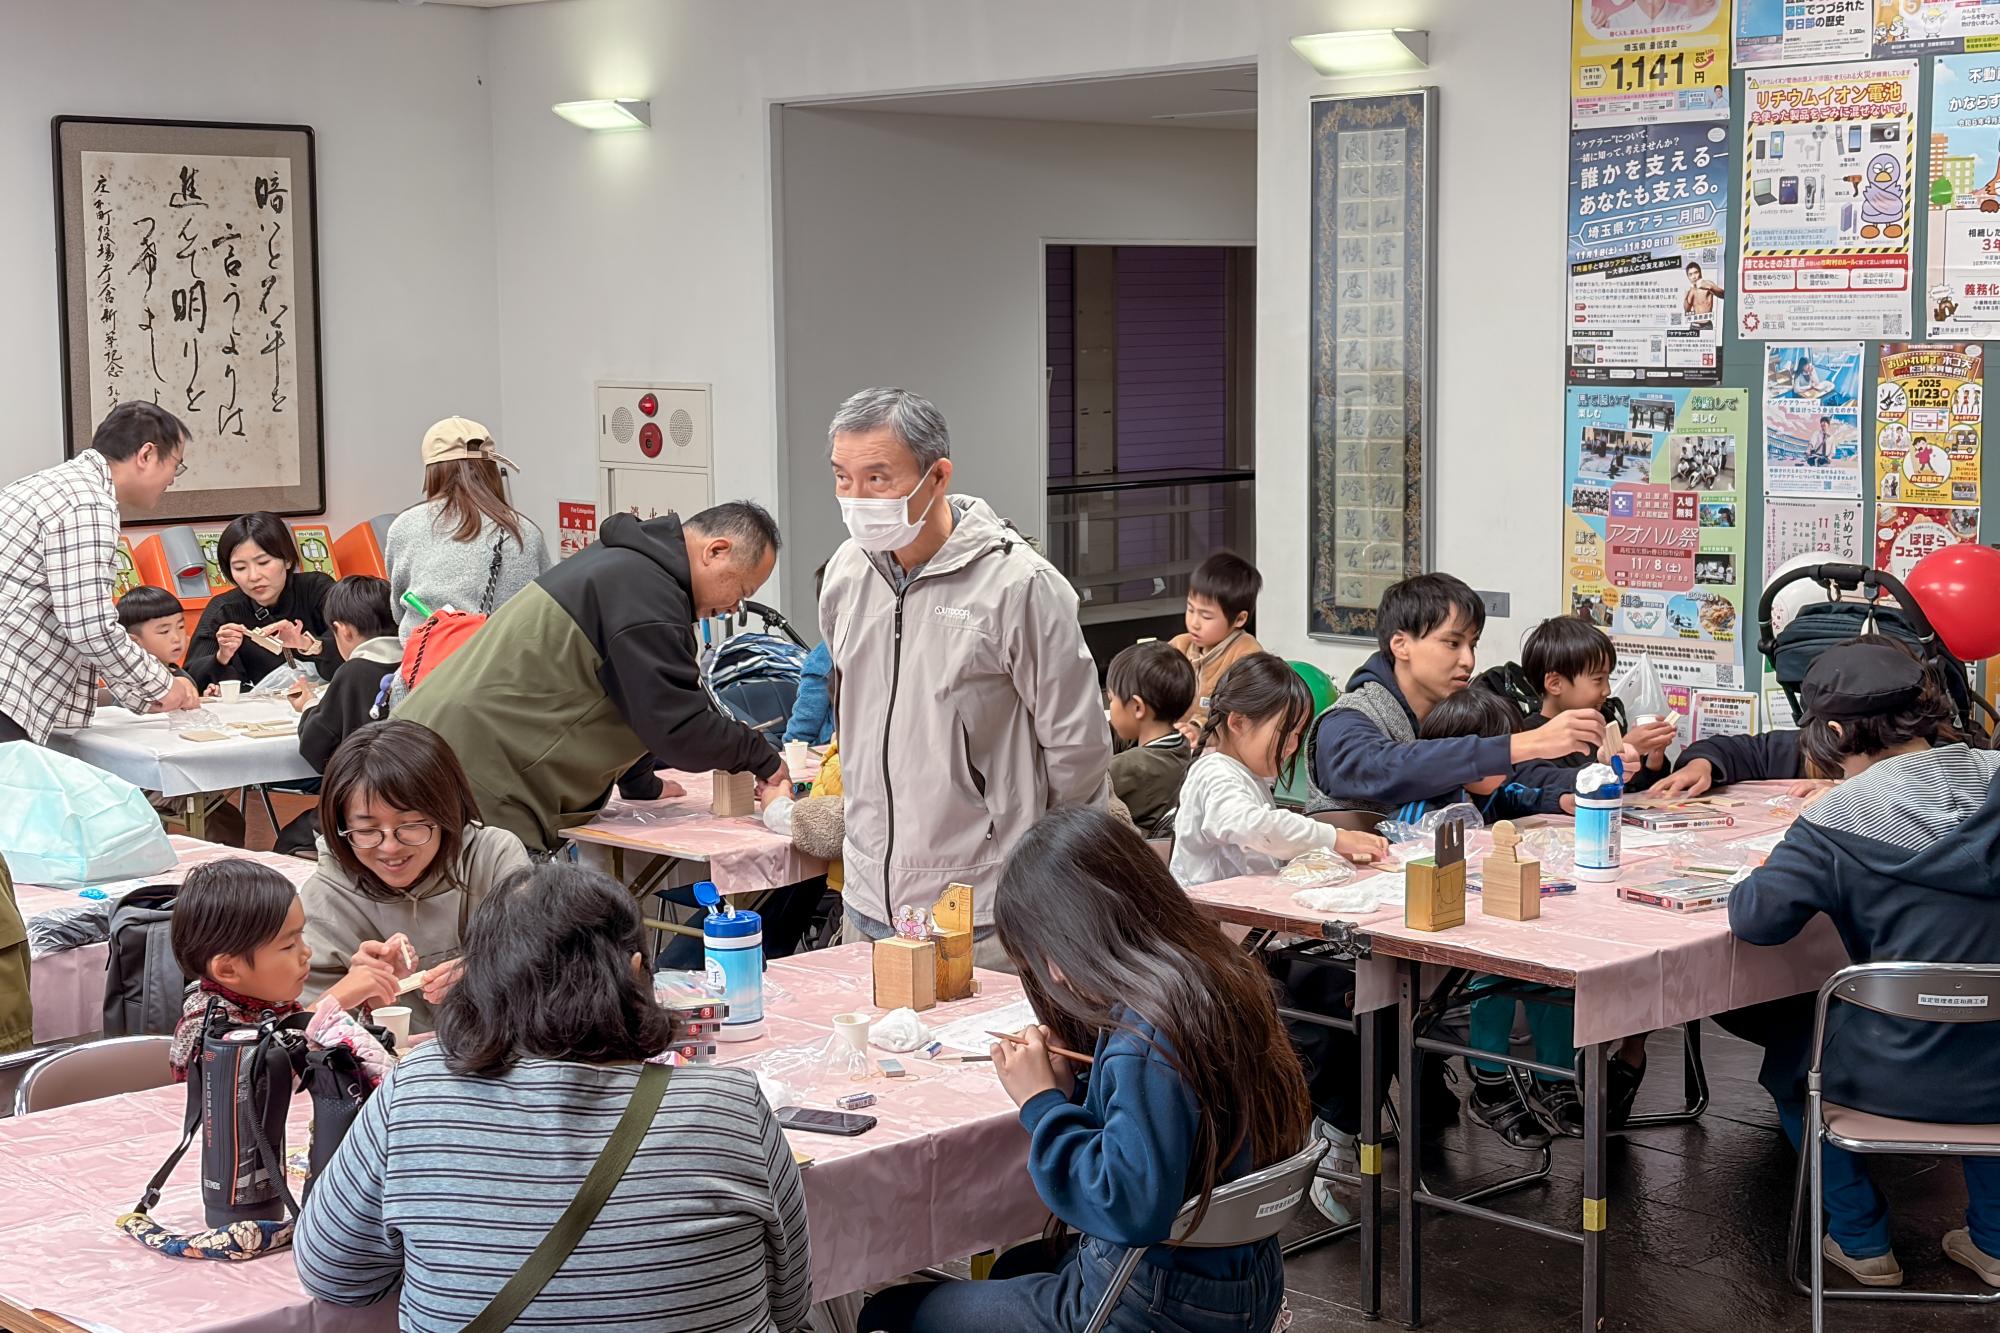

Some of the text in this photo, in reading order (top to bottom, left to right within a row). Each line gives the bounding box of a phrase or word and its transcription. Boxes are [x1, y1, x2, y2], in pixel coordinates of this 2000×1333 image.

[1786, 15, 1845, 30] 春日部の歴史
[1624, 42, 1646, 52] 埼玉県
[1611, 52, 1684, 91] 1,141
[1695, 71, 1704, 84] 円
[1969, 67, 2000, 83] 不動
[1756, 82, 1902, 109] リチウムイオン電池
[1579, 174, 1718, 216] あなたも支える。
[1587, 207, 1705, 240] 埼玉県ケアラー月間
[1744, 258, 1806, 269] 捨てるときの注意点
[1965, 283, 1999, 296] 義務化
[1762, 321, 1786, 330] 埼玉県
[1887, 355, 1974, 370] おしゃれ横丁 ホコ天
[1917, 379, 1942, 388] 2025
[1909, 388, 1939, 399] 11/23
[1691, 395, 1739, 412] 体験して
[1577, 408, 1602, 420] 楽しむ
[1691, 413, 1717, 424] 楽しむ
[1676, 496, 1694, 508] 入場
[1676, 508, 1694, 519] 無料
[1606, 523, 1700, 548] アオハル祭
[1842, 508, 1854, 559] 初めての
[1574, 545, 1598, 557] 感じる
[704, 1007, 710, 1016] 8
[691, 1024, 697, 1033] 8
[685, 1047, 691, 1055] 8
